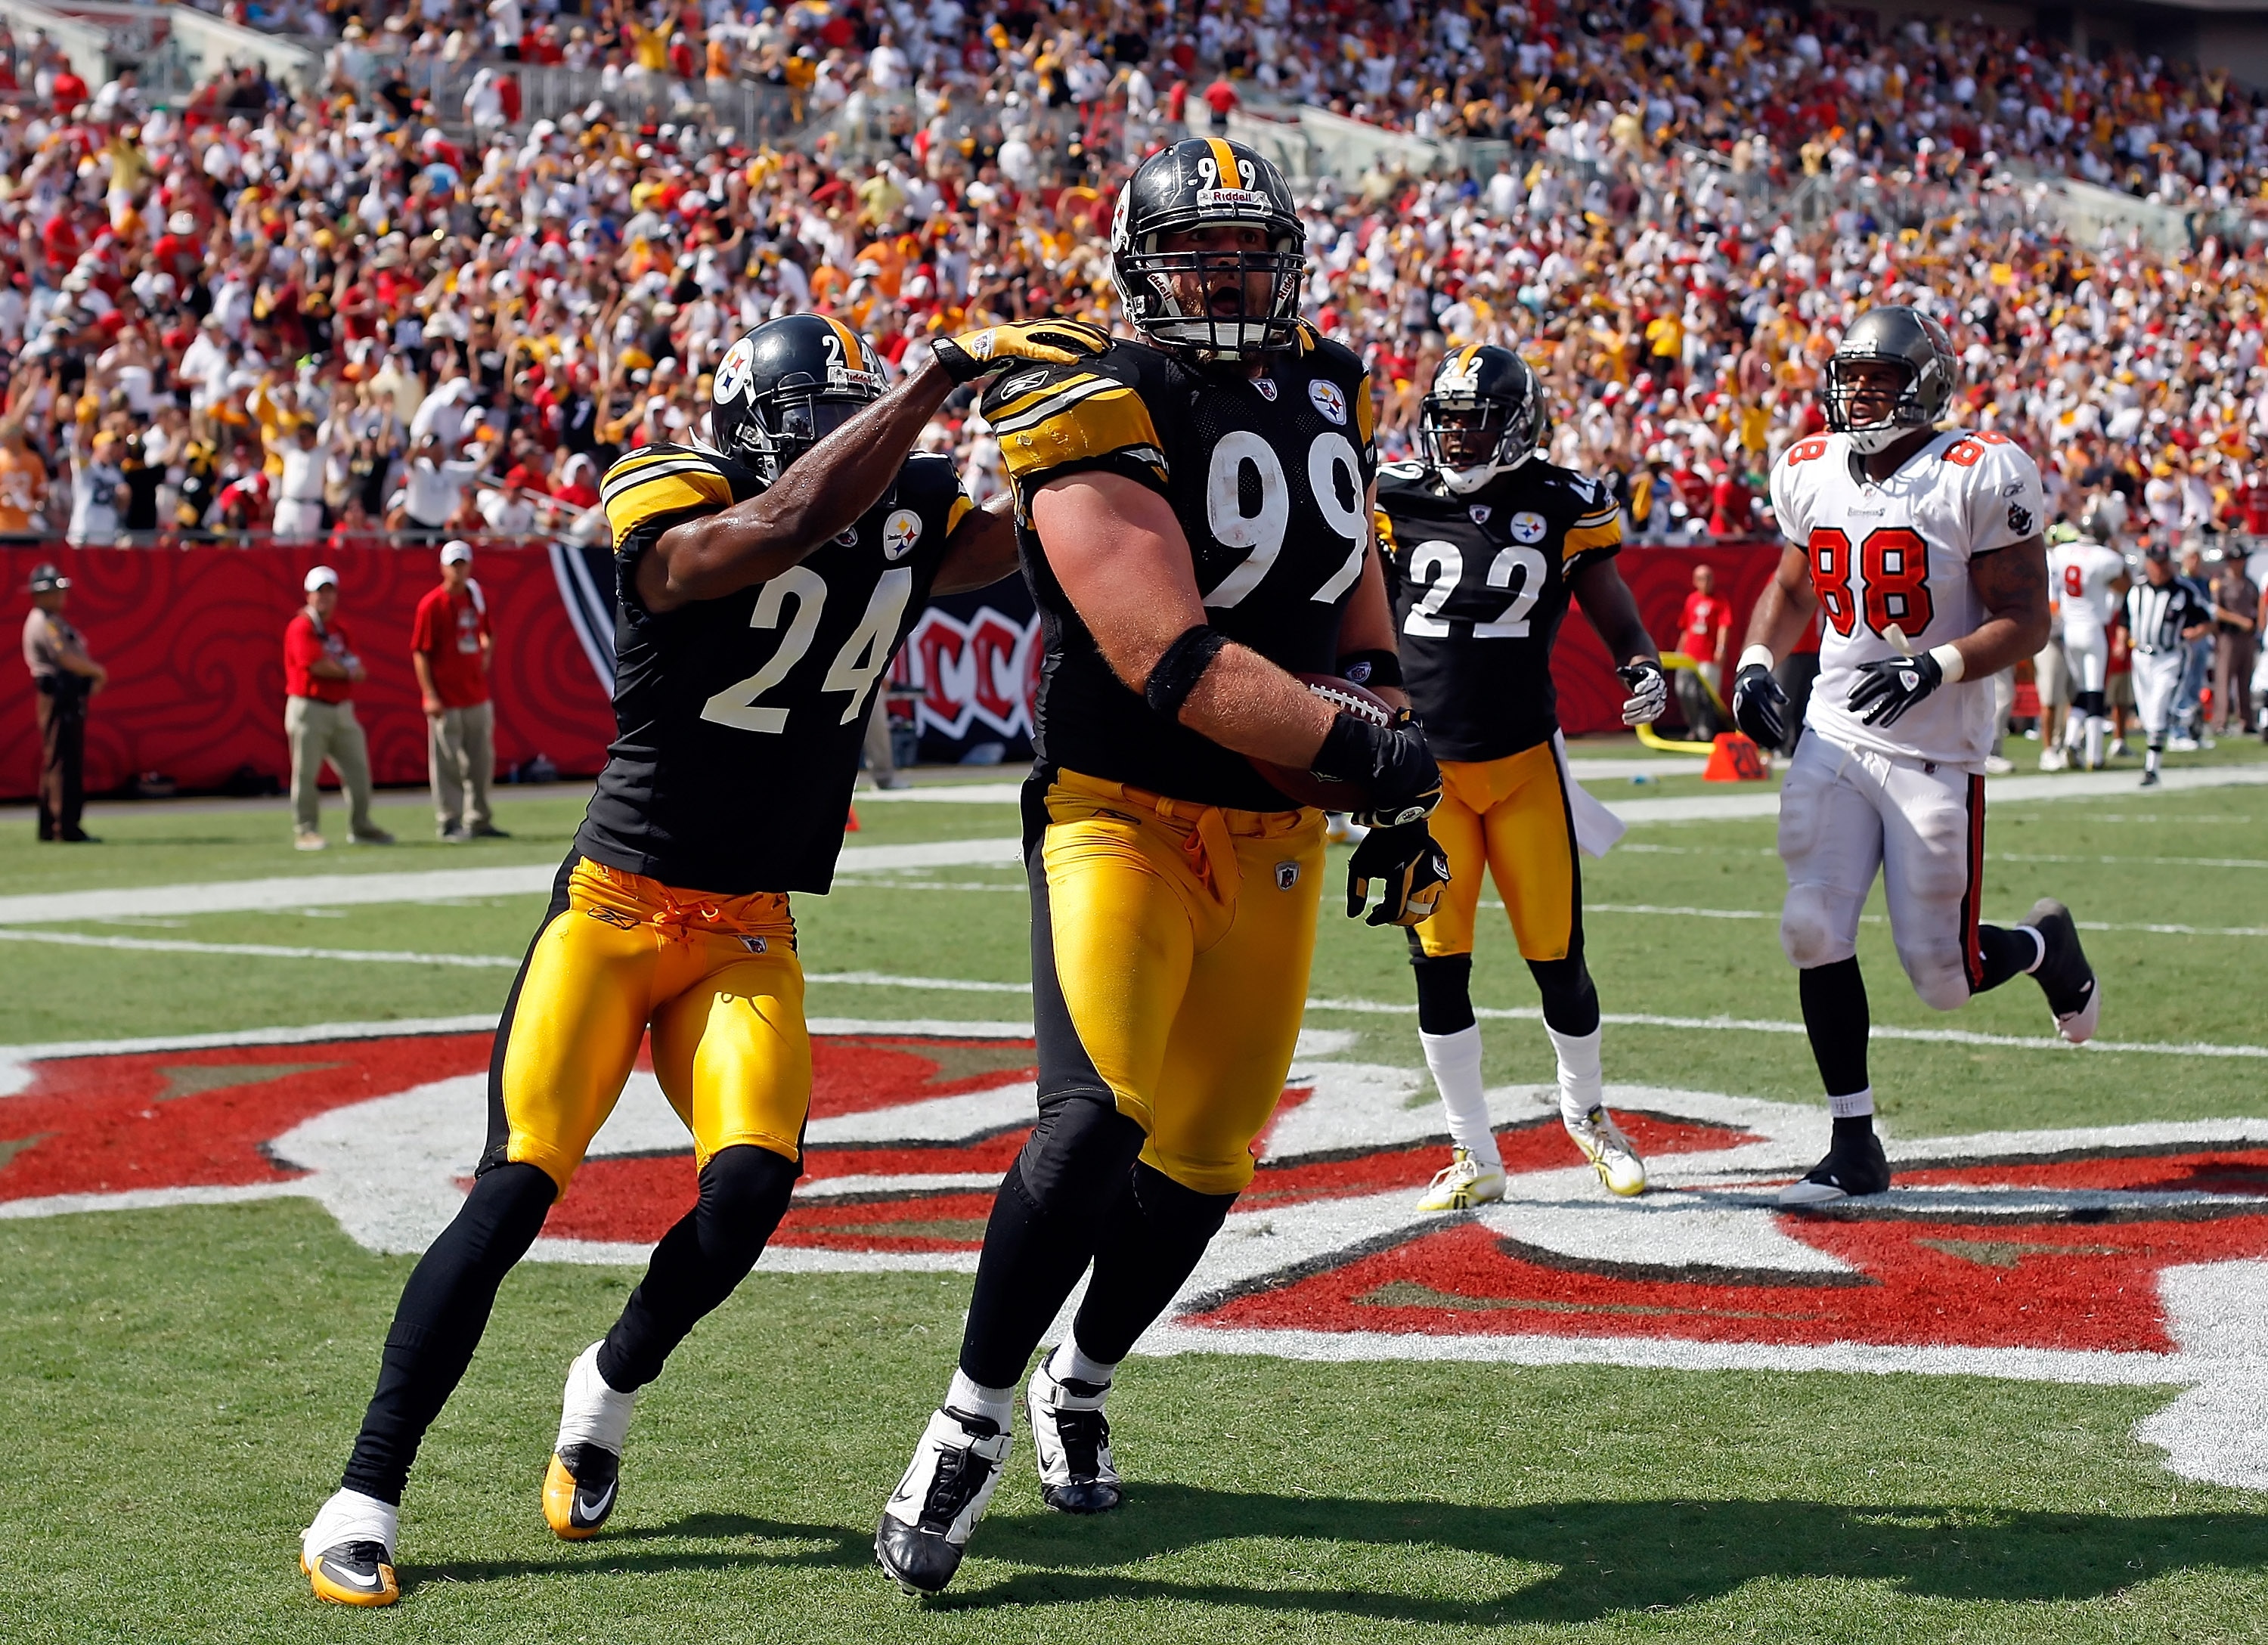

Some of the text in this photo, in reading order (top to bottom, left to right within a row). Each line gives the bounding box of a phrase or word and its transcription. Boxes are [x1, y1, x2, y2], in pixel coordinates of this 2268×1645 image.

[1213, 191, 1252, 202] Riddell
[1203, 430, 1368, 609] 99
[1403, 540, 1548, 638] 22
[1808, 526, 1935, 640] 88
[699, 565, 912, 734] 24
